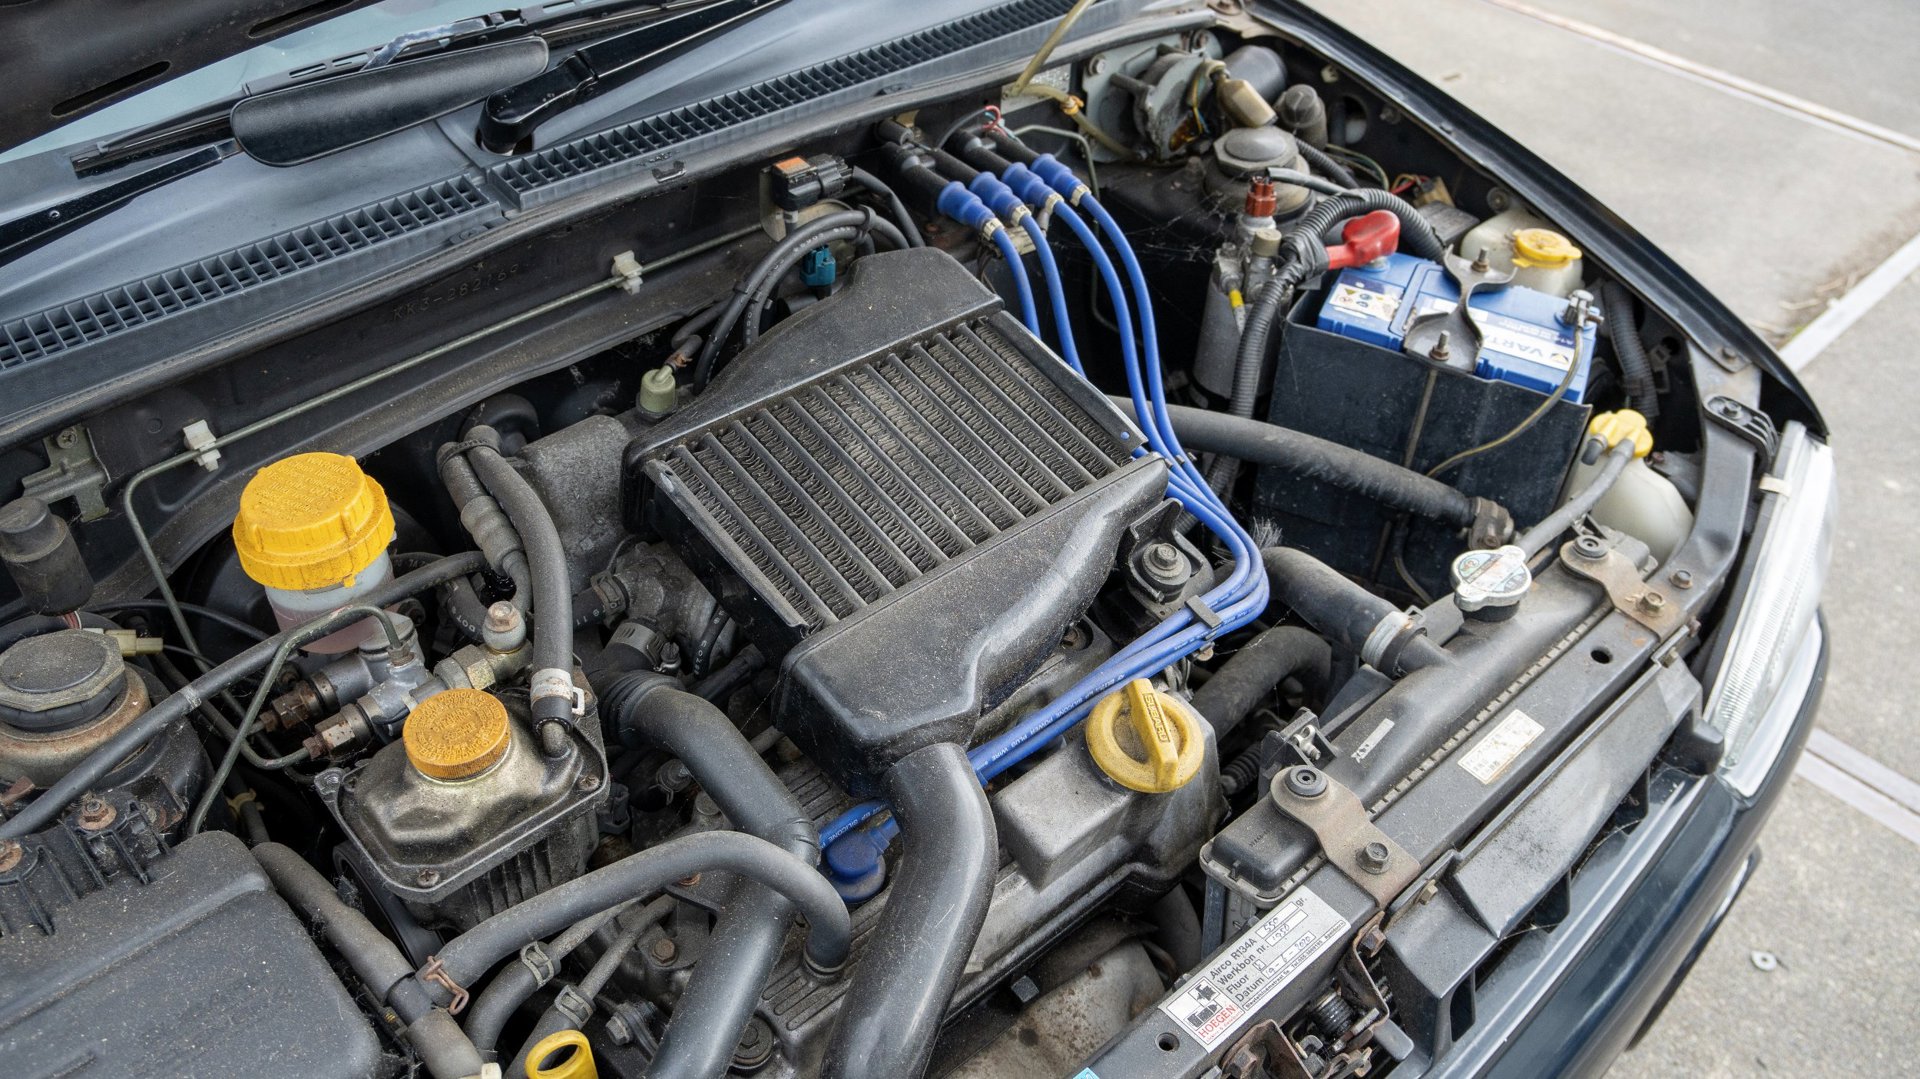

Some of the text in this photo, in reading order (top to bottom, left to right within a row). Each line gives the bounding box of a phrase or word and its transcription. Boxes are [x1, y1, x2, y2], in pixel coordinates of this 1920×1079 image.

[1030, 716, 1054, 735] POWER
[1144, 693, 1168, 742] SUBARU
[991, 747, 1009, 762] WIRE
[827, 818, 859, 841] SILICONE
[1295, 897, 1308, 907] gr.
[1210, 938, 1257, 980] Airco R134A
[1217, 944, 1269, 985] Werkbon nr.
[1226, 974, 1250, 994] Fluor
[1235, 977, 1264, 1002] Datum
[1199, 1003, 1236, 1038] HOEGEN
